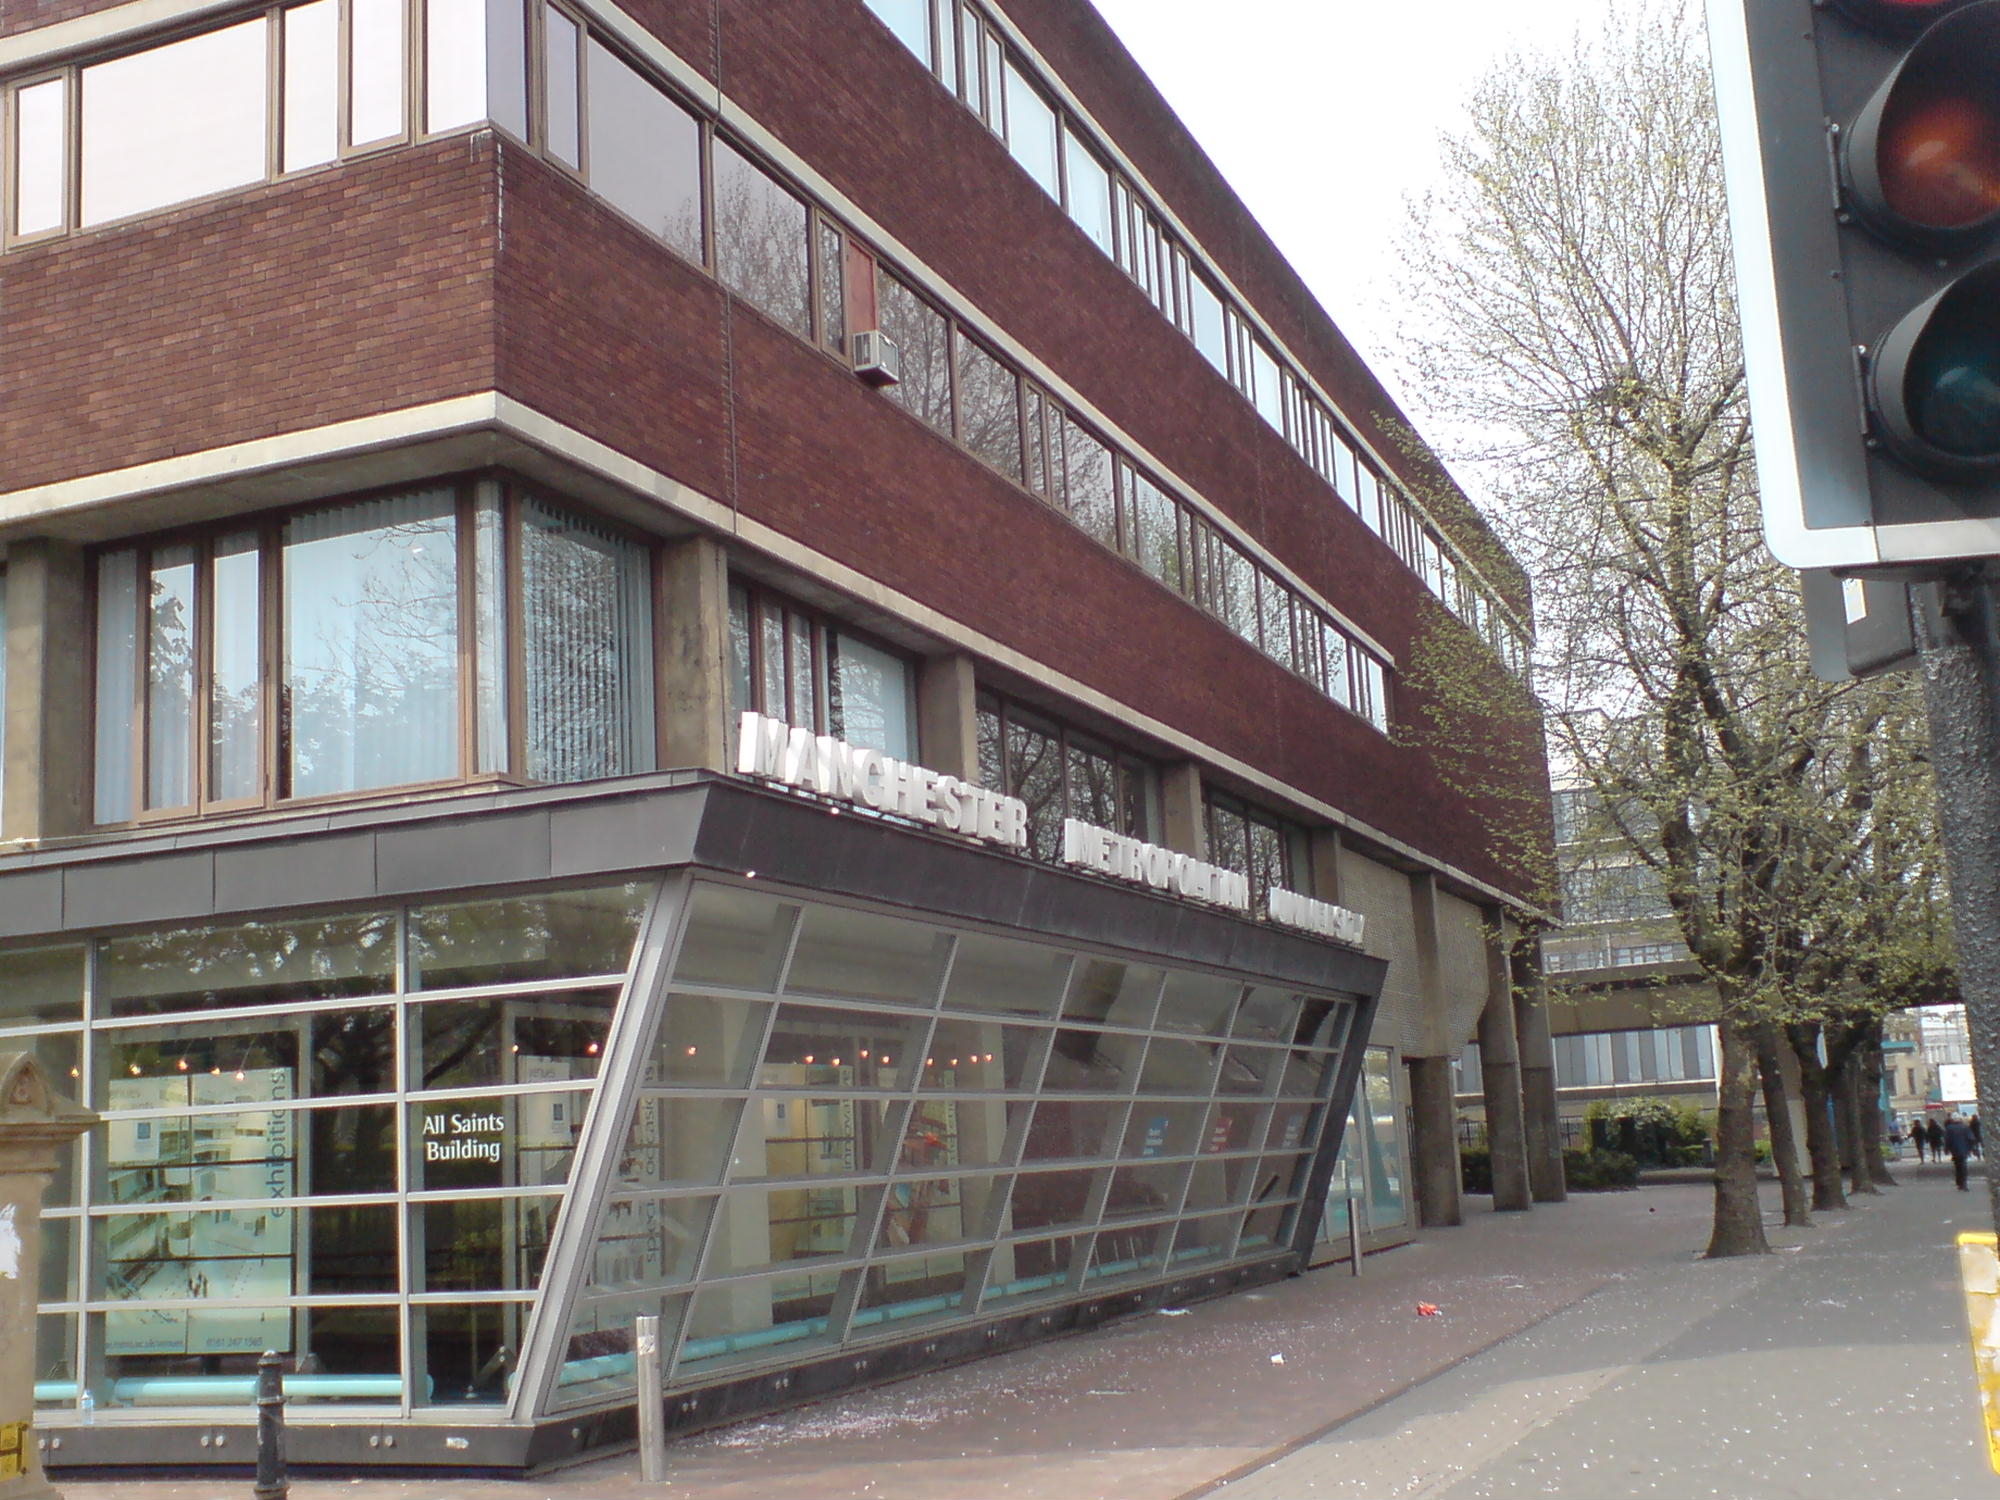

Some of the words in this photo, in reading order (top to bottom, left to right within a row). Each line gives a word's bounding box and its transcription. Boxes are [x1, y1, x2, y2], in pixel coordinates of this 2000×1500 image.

[737, 711, 1028, 848] MANCHESTER
[1064, 818, 1250, 911] METROPOLITAN
[422, 1114, 445, 1135] All
[451, 1113, 505, 1134] Saints
[426, 1139, 501, 1163] Building
